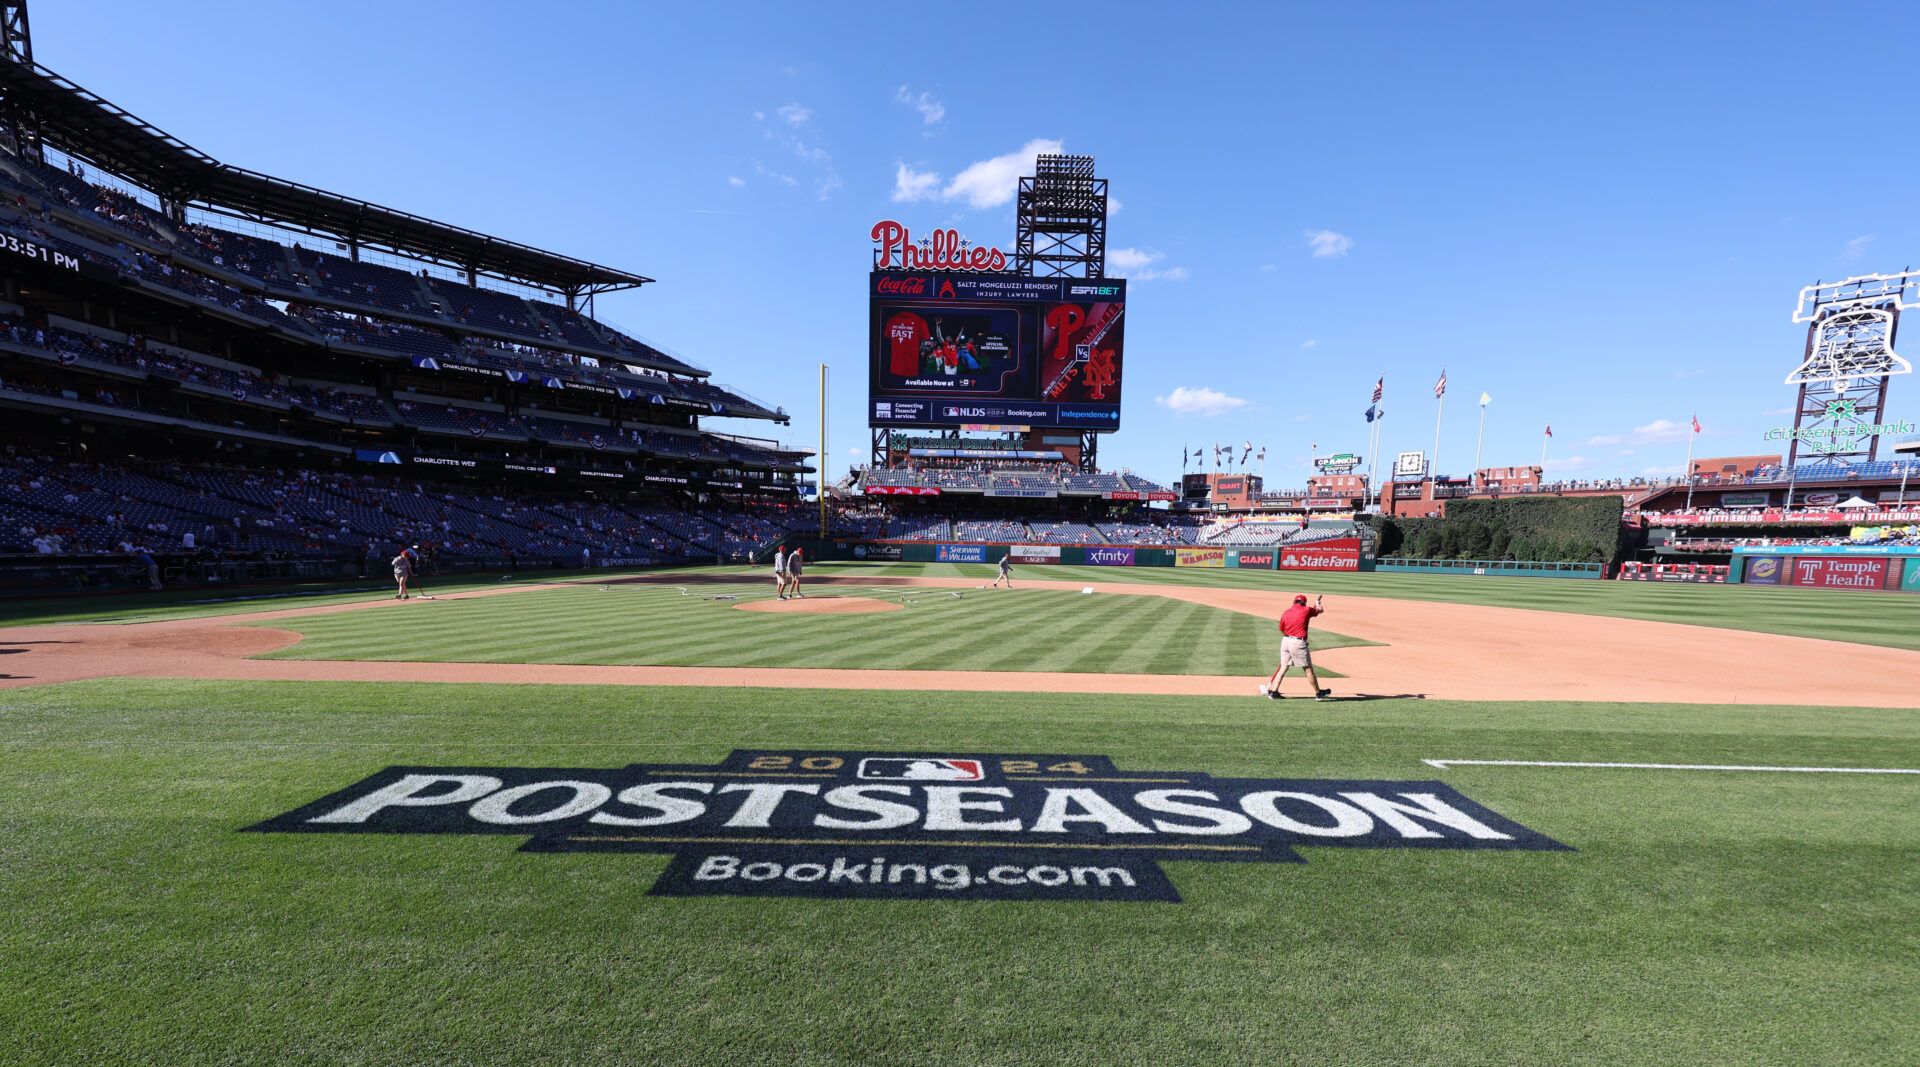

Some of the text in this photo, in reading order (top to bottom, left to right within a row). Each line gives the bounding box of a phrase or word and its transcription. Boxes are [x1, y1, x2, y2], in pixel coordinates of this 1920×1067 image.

[870, 219, 1006, 271] Phillies
[54, 251, 79, 272] PM
[1070, 286, 1120, 295] ESPN BET
[891, 329, 914, 340] EAST
[1078, 347, 1088, 359] VS
[442, 362, 479, 373] CHARLOTTE'S
[565, 382, 595, 391] CHARLOTTE'S
[905, 379, 933, 387] Available
[1050, 368, 1078, 398] METS
[960, 408, 986, 417] NLDS
[1007, 409, 1047, 418] Booking.com
[1061, 410, 1109, 419] Independence
[1767, 419, 1911, 440] Citizens Bank
[909, 437, 1024, 451] Citizens Bank Park
[1811, 438, 1857, 453] Park
[413, 457, 460, 466] CHARLOTTE'S
[1317, 457, 1359, 466] CP RANKIN
[644, 475, 677, 483] CHARLOTTE'S
[867, 545, 902, 554] NovaCare
[949, 545, 981, 554] SHERWIN
[609, 558, 651, 566] POSTSEASON
[1090, 549, 1130, 564] xfinity
[1239, 555, 1273, 564] GIANT
[1827, 560, 1882, 574] Temple
[1825, 573, 1876, 587] Health
[747, 755, 1094, 774] 20 24
[305, 772, 1517, 840] POSTSEASON
[693, 854, 1140, 890] Booking.com
